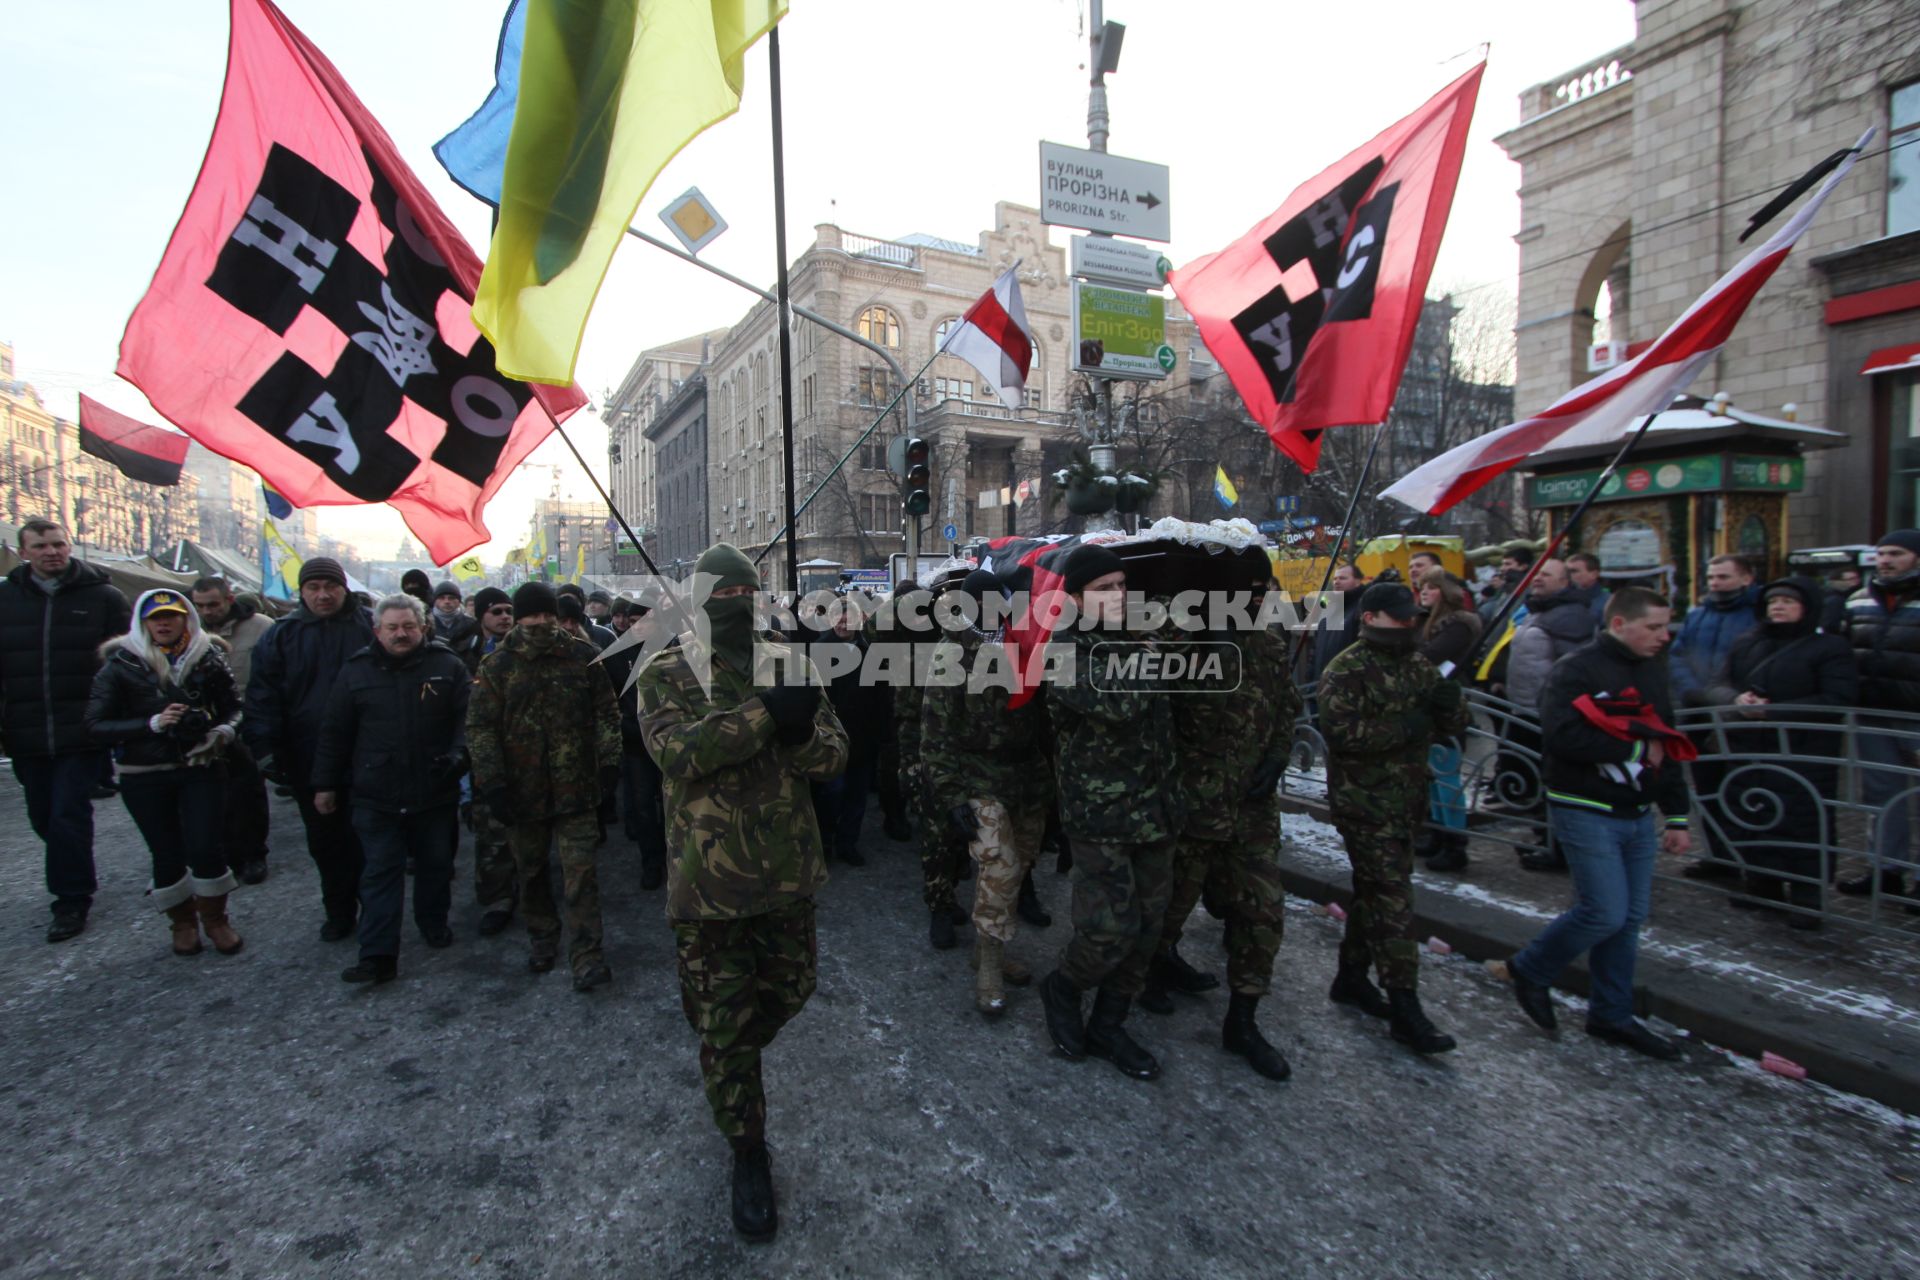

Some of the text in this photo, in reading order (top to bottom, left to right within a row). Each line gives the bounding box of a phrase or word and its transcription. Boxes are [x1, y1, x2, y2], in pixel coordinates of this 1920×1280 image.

[1047, 159, 1103, 180] вулиця
[1047, 175, 1130, 205] ПРОРІЗНА
[1048, 198, 1130, 223] PRORIZNA Str.
[1081, 313, 1163, 344] ЕлітЗоо
